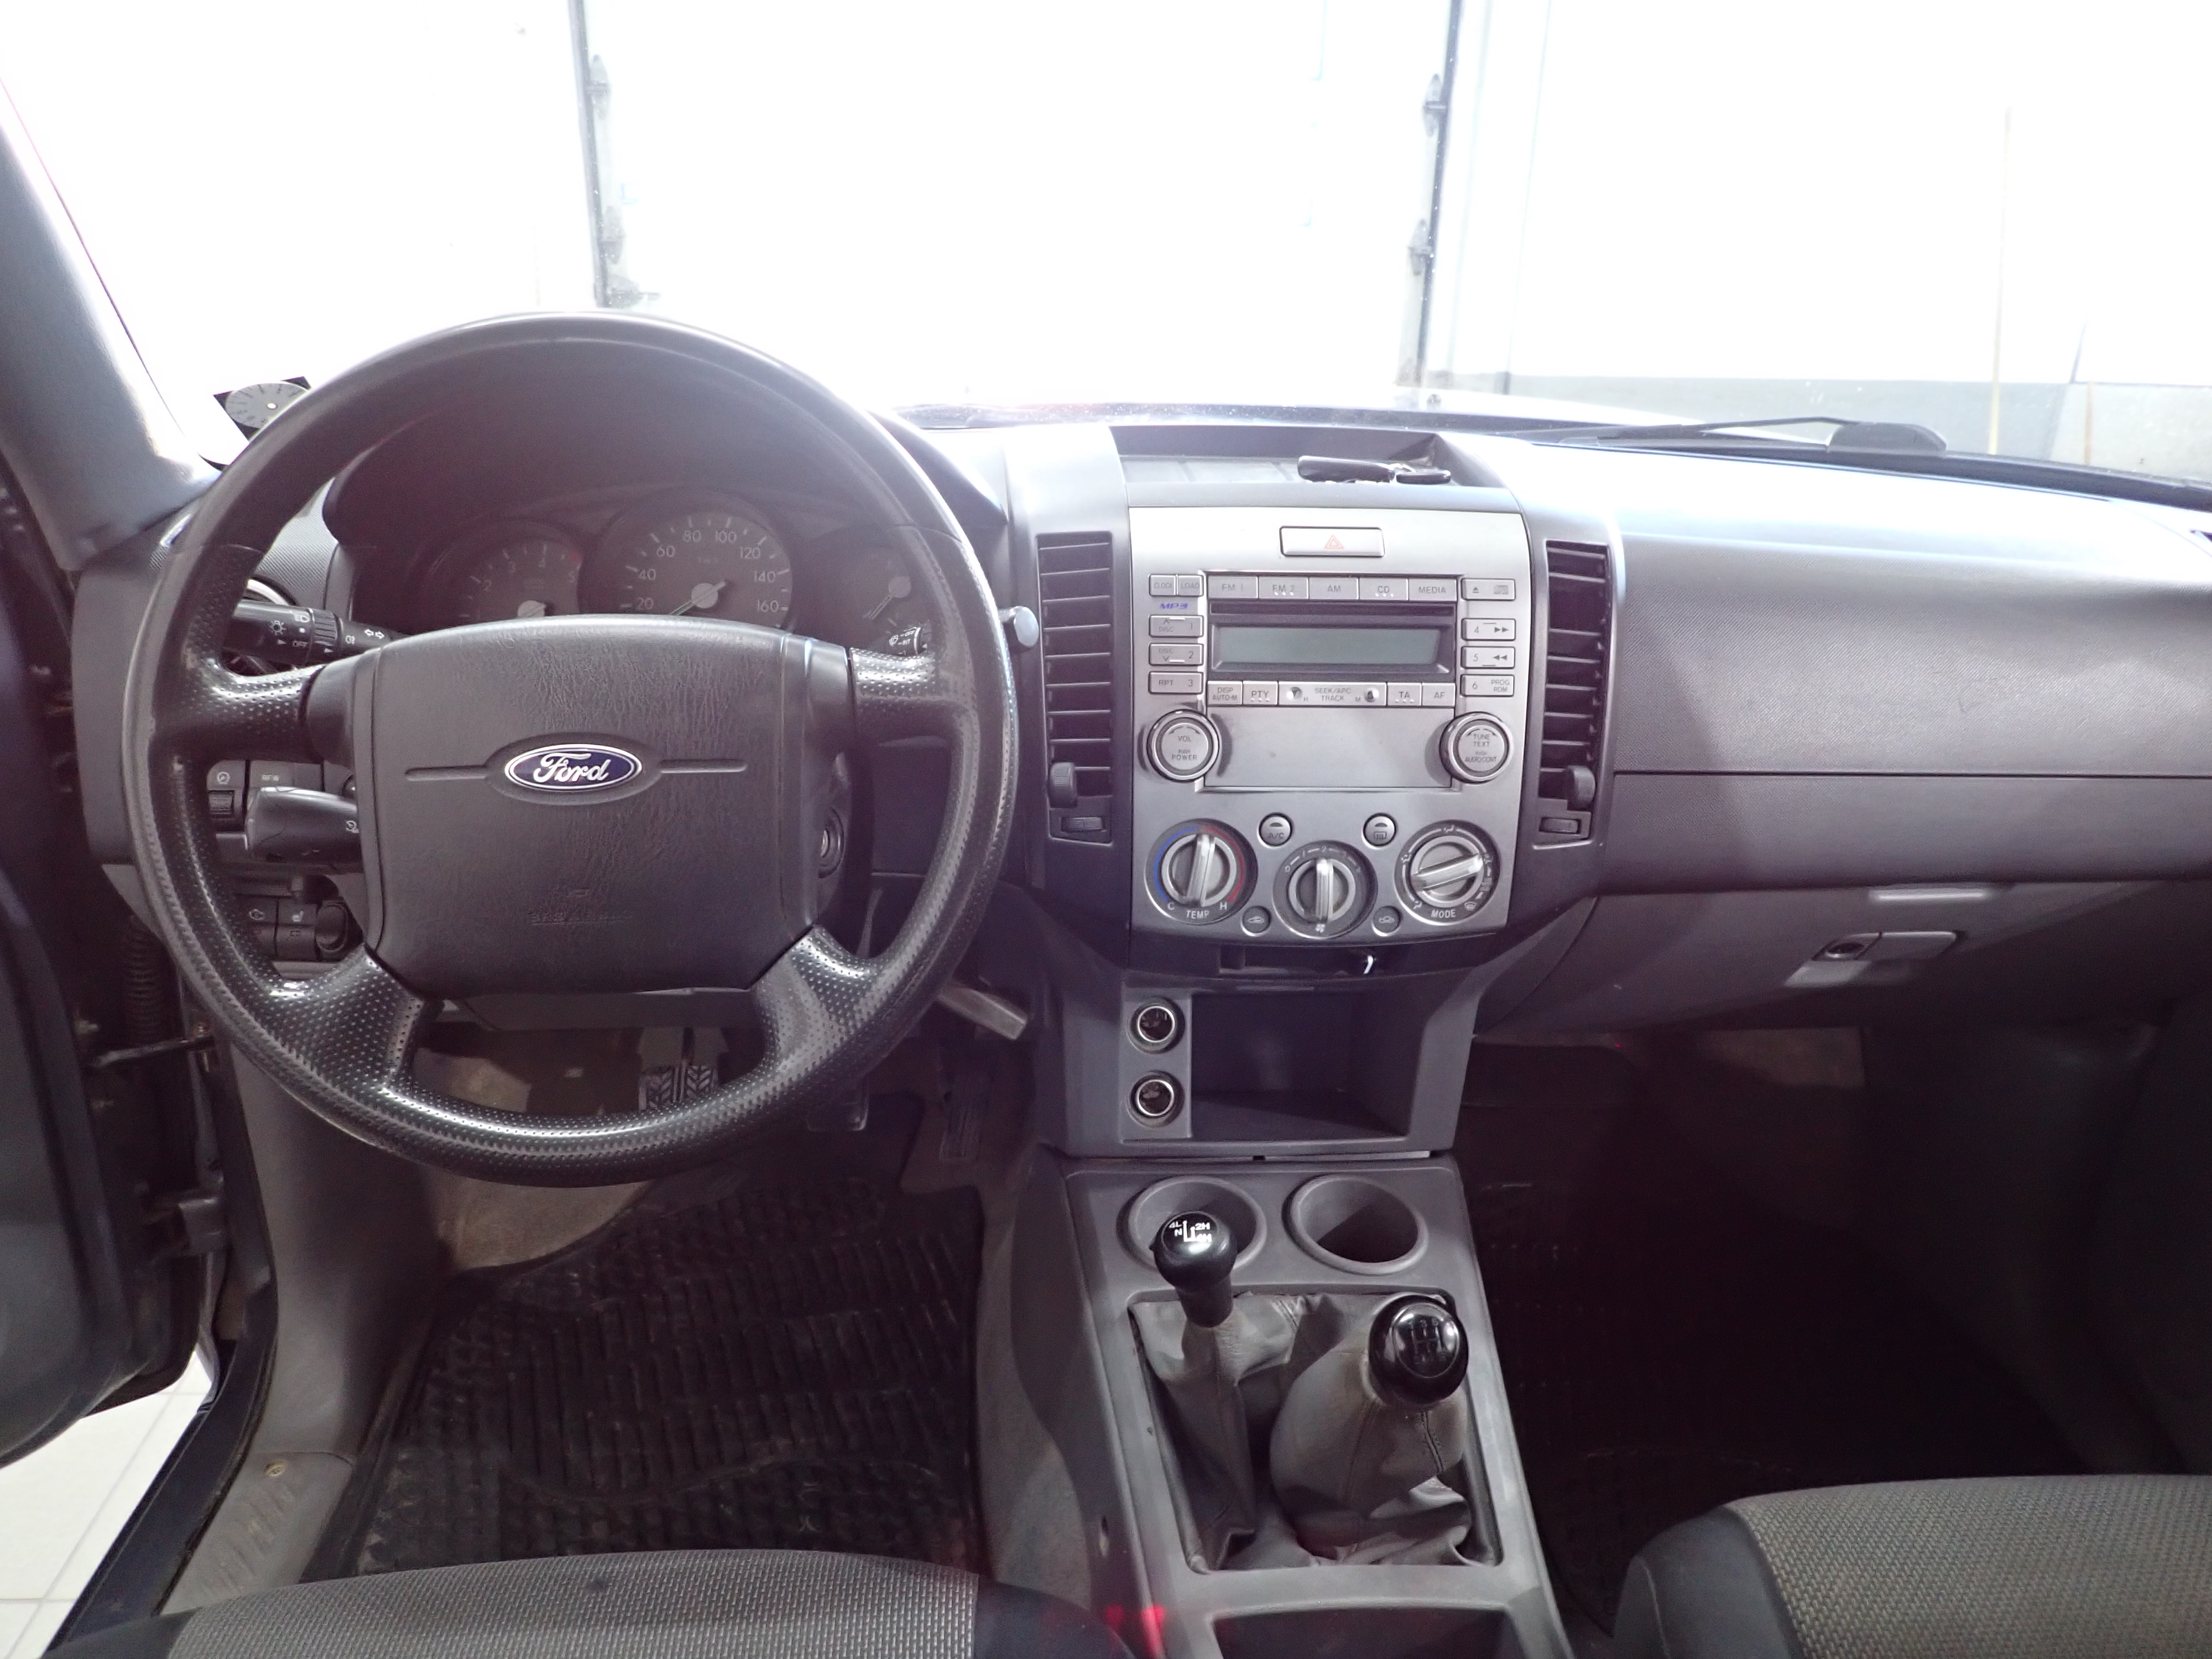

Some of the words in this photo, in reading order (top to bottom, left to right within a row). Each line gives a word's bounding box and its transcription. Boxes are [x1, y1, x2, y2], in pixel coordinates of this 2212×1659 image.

[682, 529, 702, 543] 80
[714, 530, 738, 544] 100
[656, 544, 676, 558] 60
[739, 546, 761, 560] 120
[638, 568, 657, 581] 40
[753, 570, 776, 583] 140
[483, 579, 492, 592] 2
[1272, 584, 1286, 592] FM
[1418, 586, 1447, 594] MEDIA
[636, 597, 654, 610] 20
[757, 599, 780, 613] 160
[1188, 651, 1194, 659] 2
[1472, 681, 1478, 690] 6
[533, 752, 612, 782] Ford
[1167, 902, 1175, 910] C
[1219, 901, 1228, 910] H
[1186, 910, 1210, 919] TEMP
[1431, 909, 1457, 919] MODE
[1174, 1228, 1183, 1237] N
